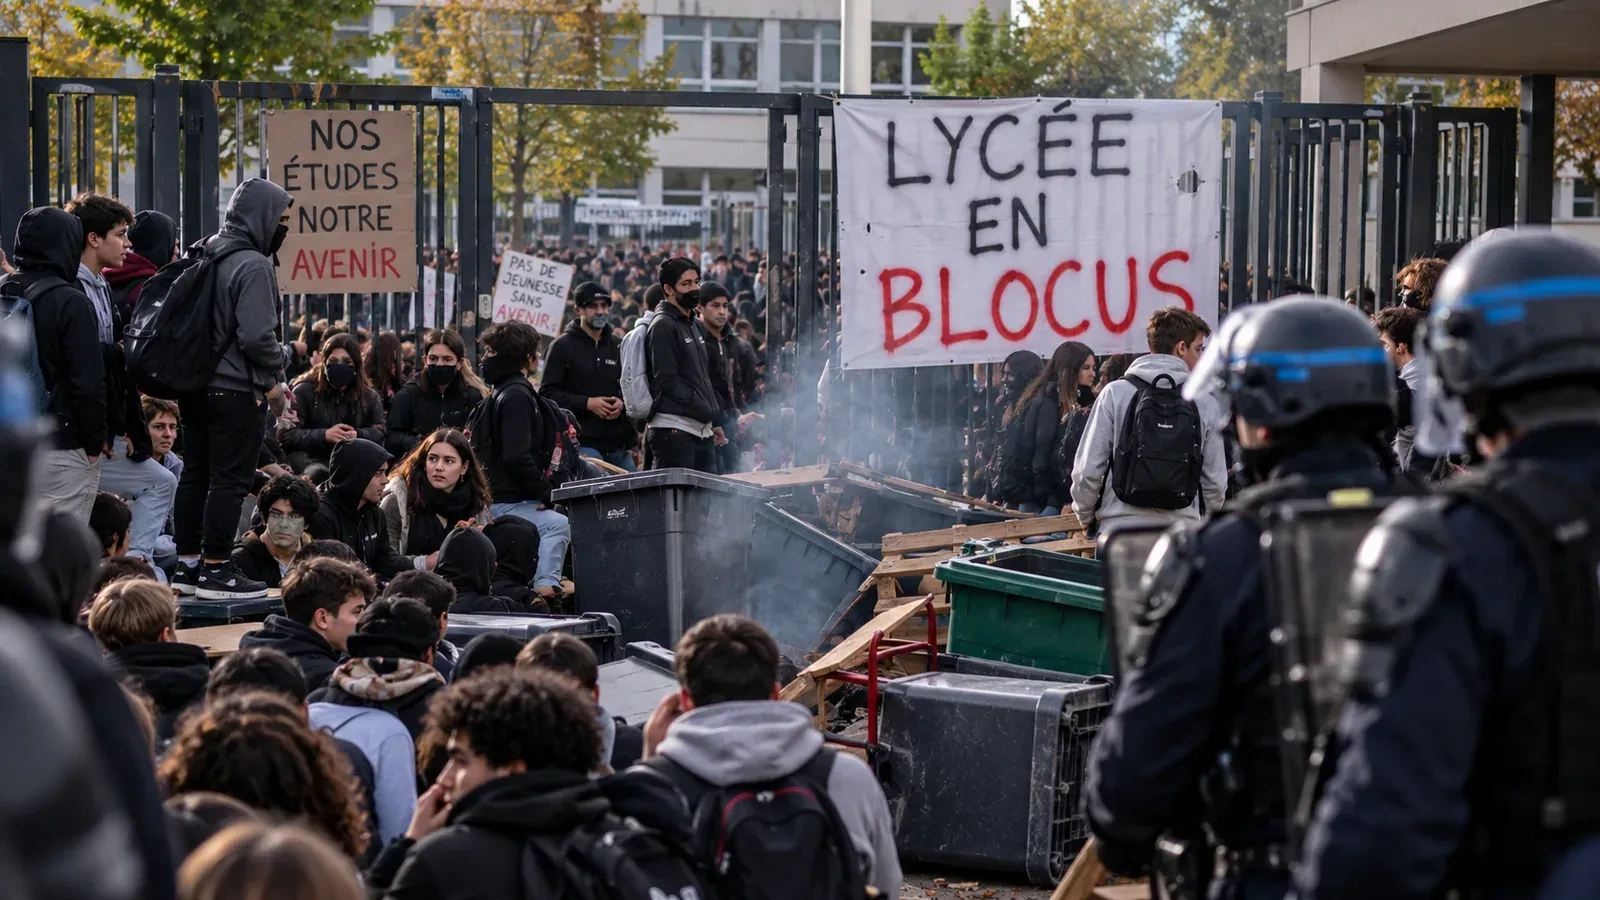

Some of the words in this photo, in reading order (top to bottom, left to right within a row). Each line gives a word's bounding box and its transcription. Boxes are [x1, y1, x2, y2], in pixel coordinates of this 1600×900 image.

[311, 118, 381, 151] NOS
[887, 100, 1134, 187] LYCÉE
[283, 154, 399, 191] ÉTUDES
[299, 203, 393, 233] NOTRE
[968, 192, 1048, 255] EN
[509, 255, 534, 273] PAS
[539, 263, 557, 279] DE
[502, 272, 564, 299] JEUNESSE
[510, 289, 542, 308] SANS
[879, 250, 1195, 354] BLOCUS
